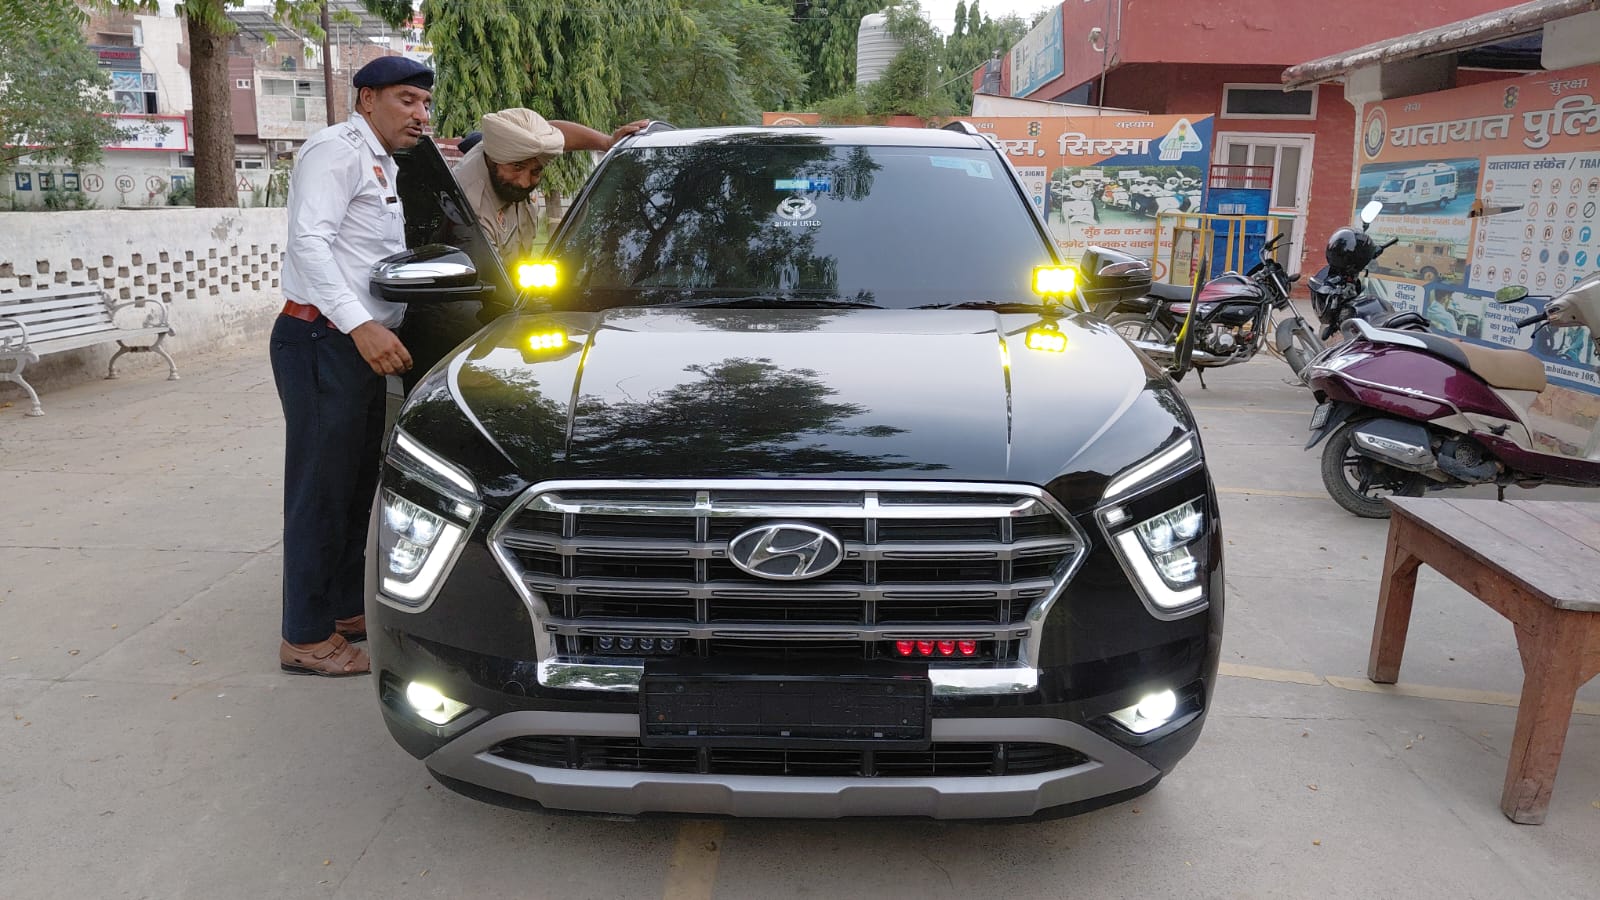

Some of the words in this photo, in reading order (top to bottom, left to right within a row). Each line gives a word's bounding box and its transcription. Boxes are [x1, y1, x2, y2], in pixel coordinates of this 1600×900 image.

[1391, 114, 1514, 147] यातायात
[1057, 132, 1152, 157] सिरसा
[1488, 160, 1529, 170] यातायात
[1533, 157, 1567, 170] संकेत
[120, 179, 131, 188] 50
[1546, 364, 1580, 378] mbulance
